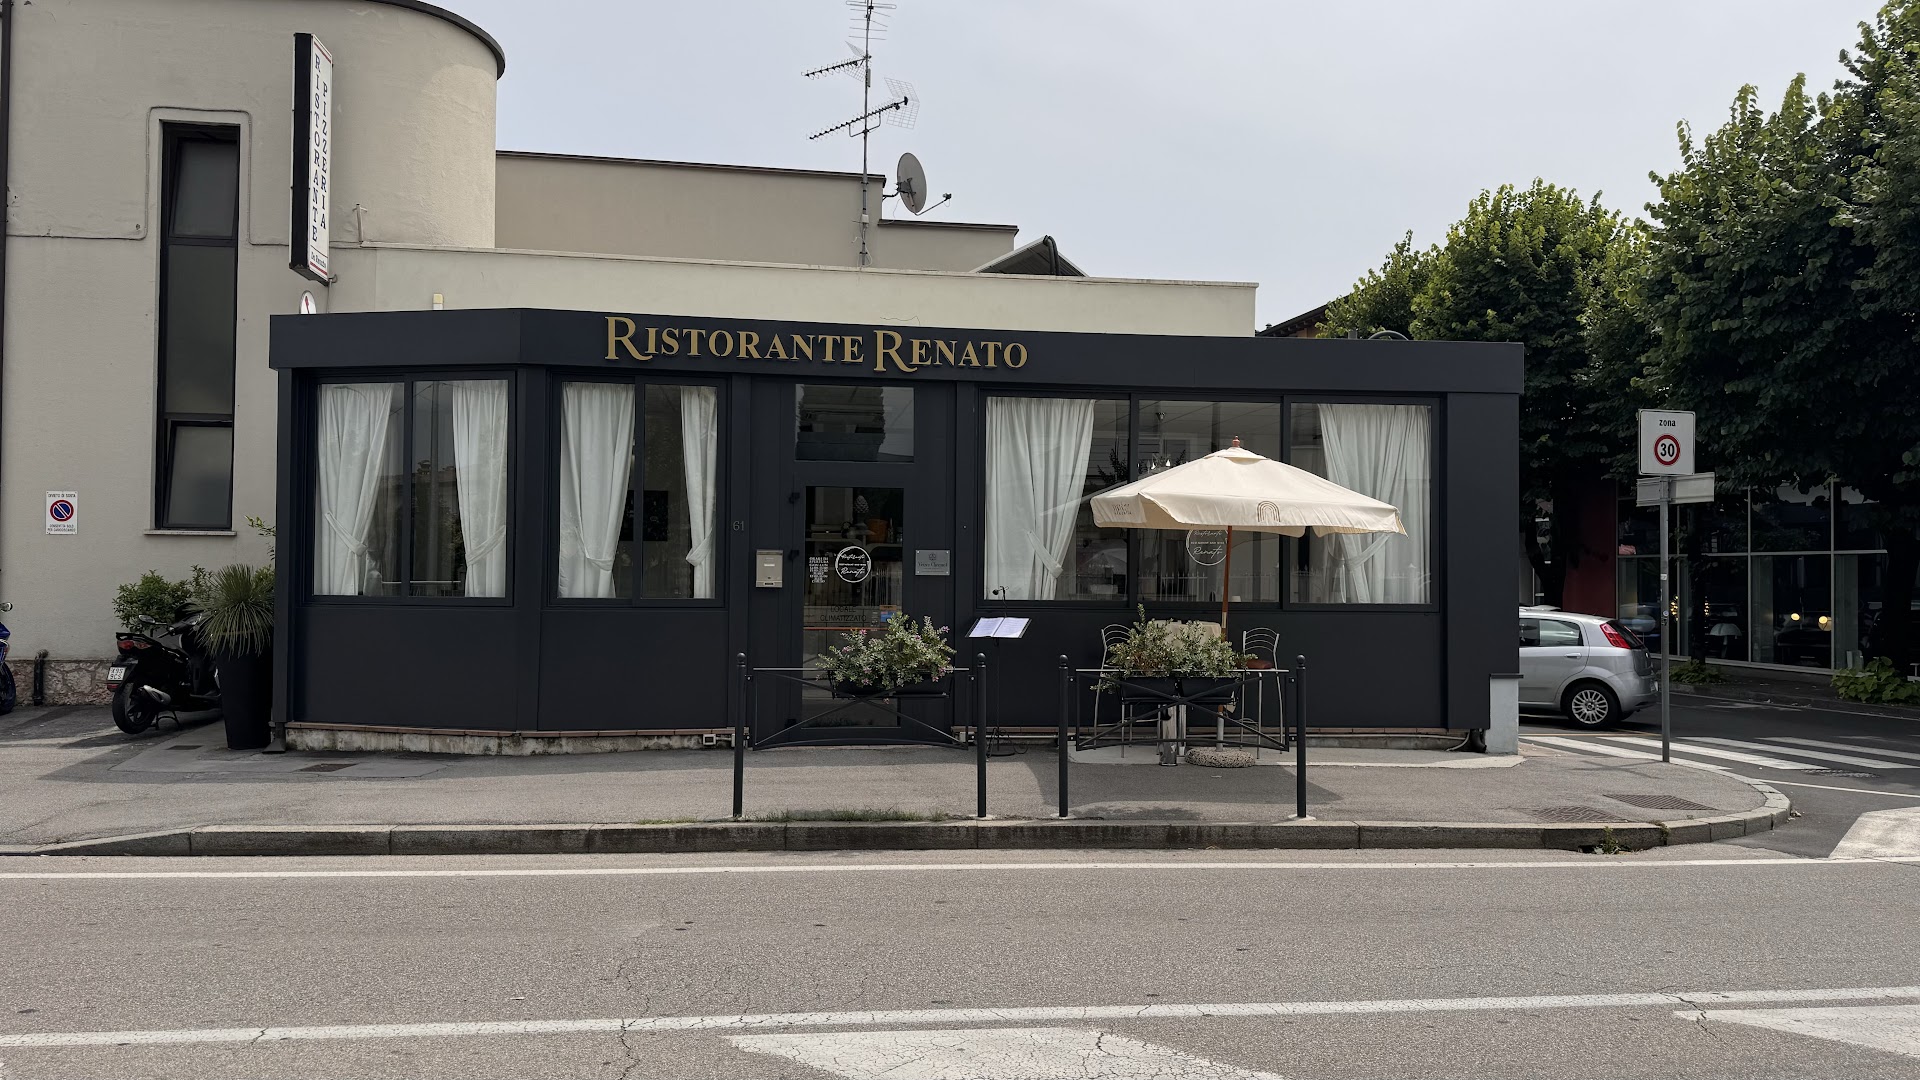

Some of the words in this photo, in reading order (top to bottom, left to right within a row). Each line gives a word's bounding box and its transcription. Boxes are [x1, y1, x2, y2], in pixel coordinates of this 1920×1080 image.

[312, 53, 321, 242] RISTORANTE
[320, 81, 329, 230] PIZZERIA
[604, 316, 864, 363] RISTORANTE
[873, 330, 1028, 373] RENATO
[1660, 443, 1675, 458] 30
[733, 520, 744, 531] 61
[1193, 545, 1223, 559] Renato
